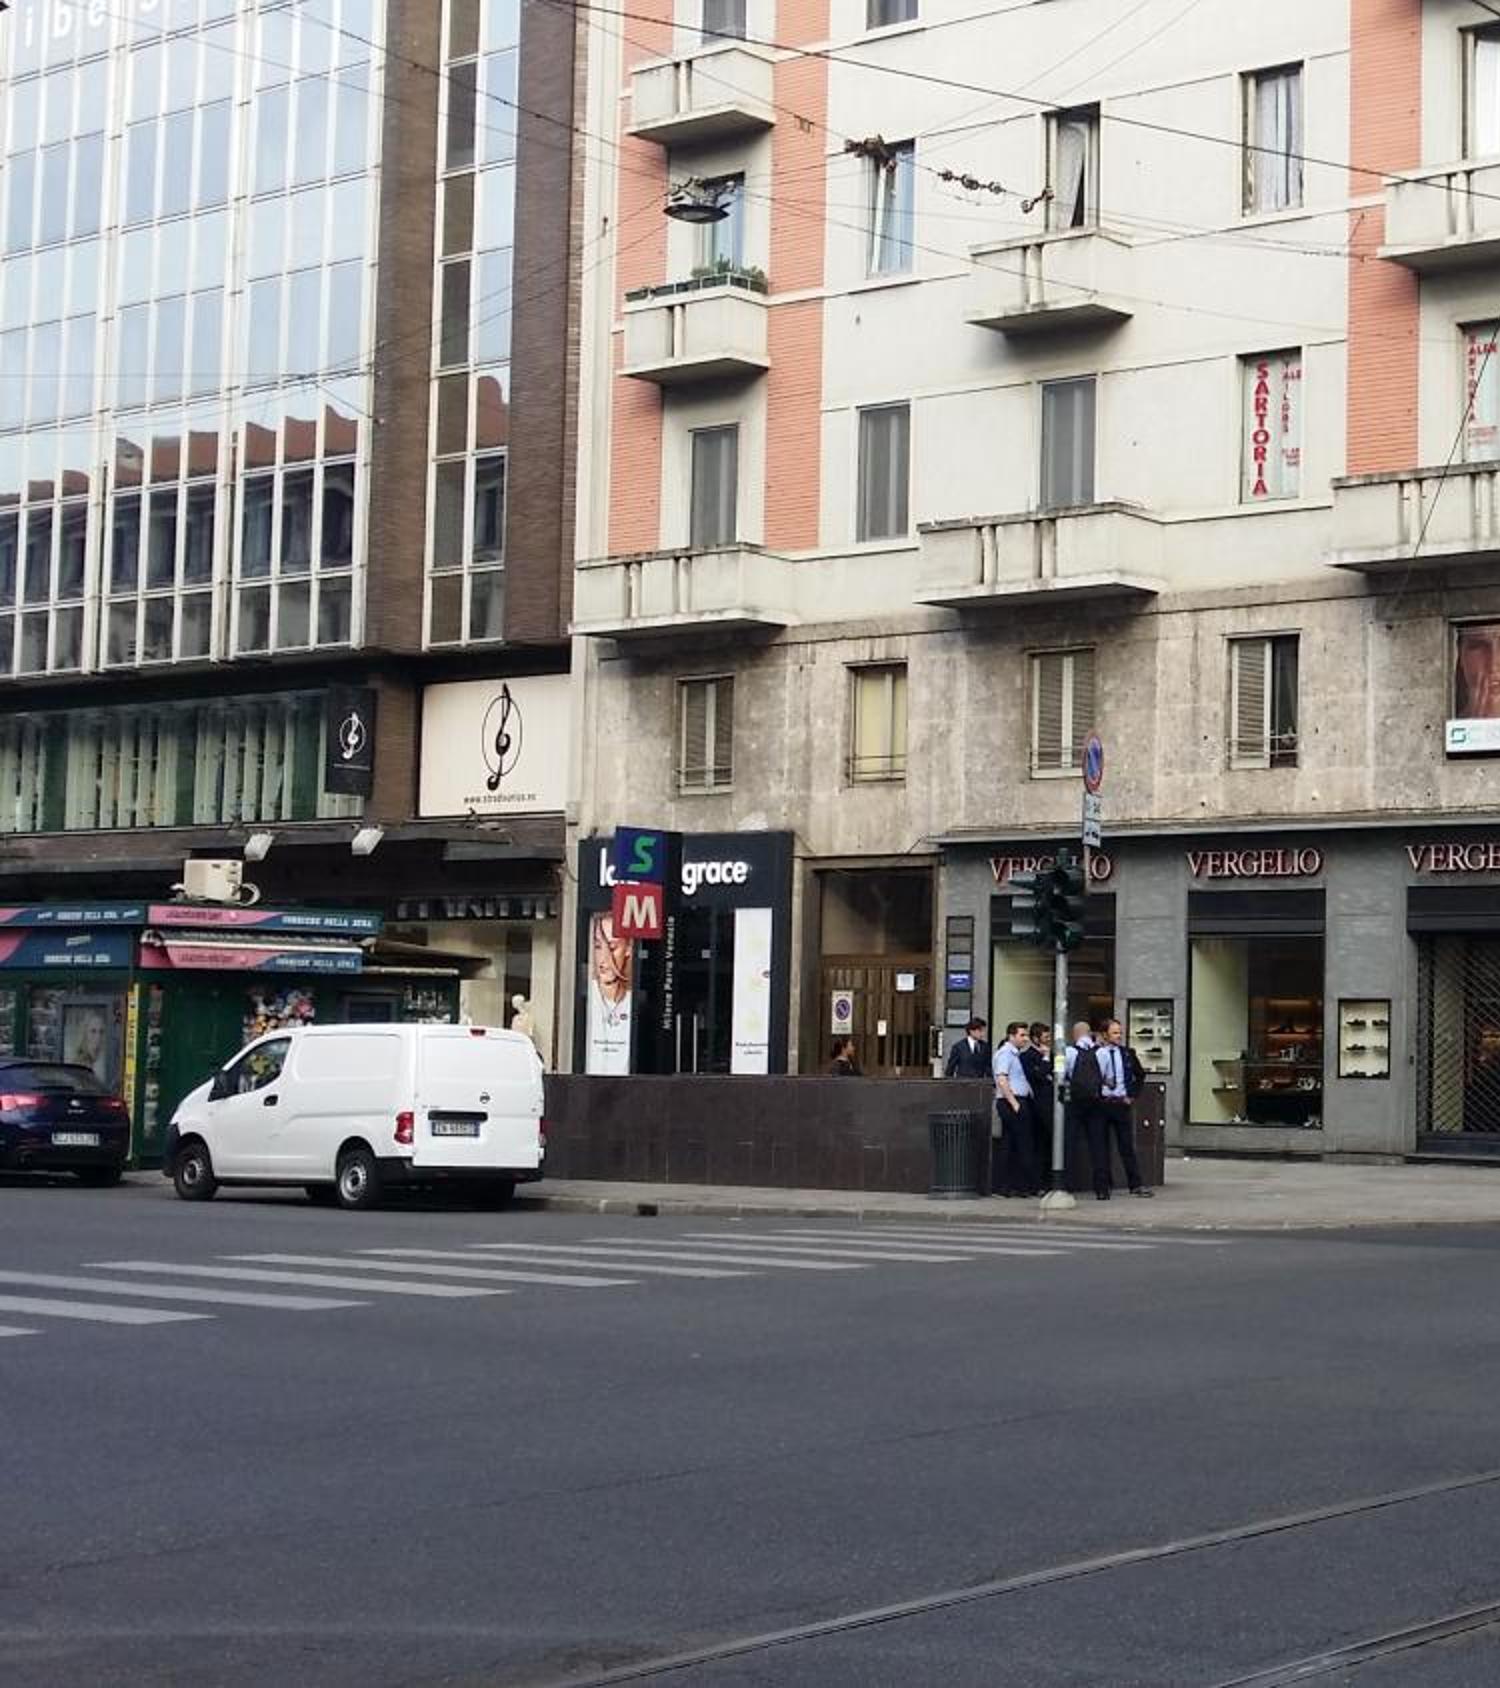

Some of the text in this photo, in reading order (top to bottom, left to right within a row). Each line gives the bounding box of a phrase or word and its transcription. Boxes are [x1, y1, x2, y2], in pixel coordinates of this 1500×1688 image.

[1253, 361, 1270, 495] SARTORIA
[627, 836, 657, 873] S
[1186, 847, 1321, 877] VERGELIO
[621, 895, 658, 928] M
